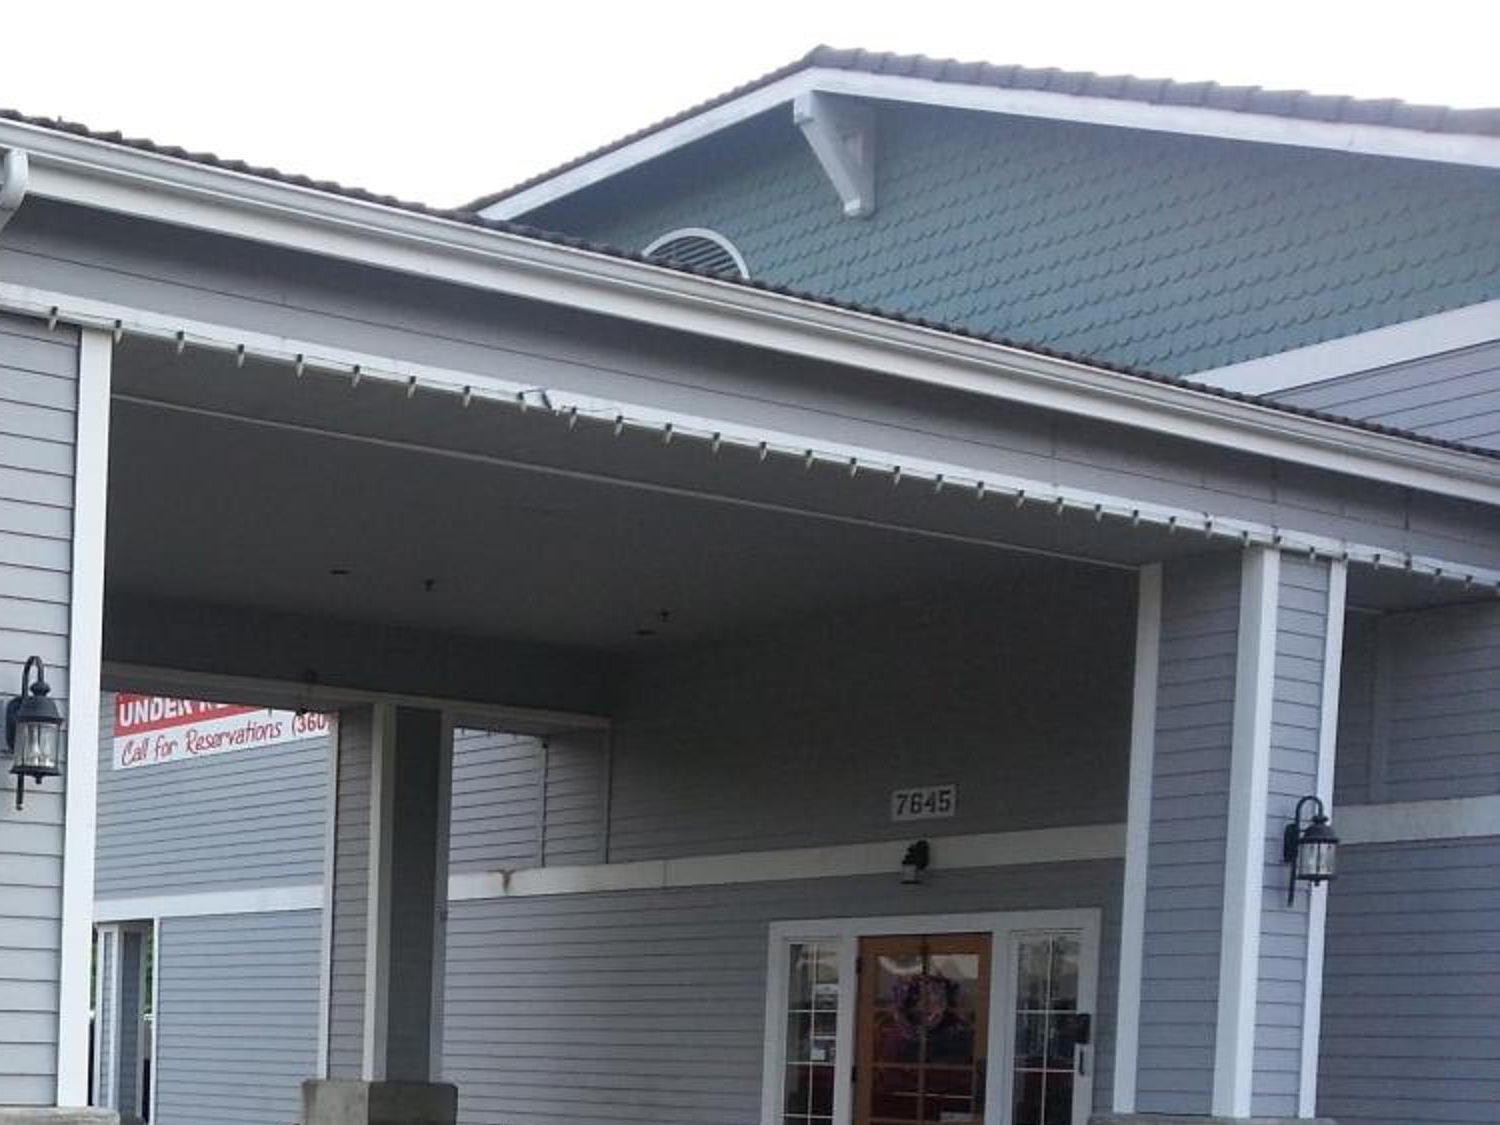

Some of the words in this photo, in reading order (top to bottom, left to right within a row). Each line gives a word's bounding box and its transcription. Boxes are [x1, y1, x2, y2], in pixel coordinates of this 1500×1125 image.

[119, 697, 193, 727] UNDER
[121, 737, 149, 767] Call
[155, 734, 178, 762] for
[186, 720, 282, 755] Reservations
[896, 789, 951, 816] 7645
